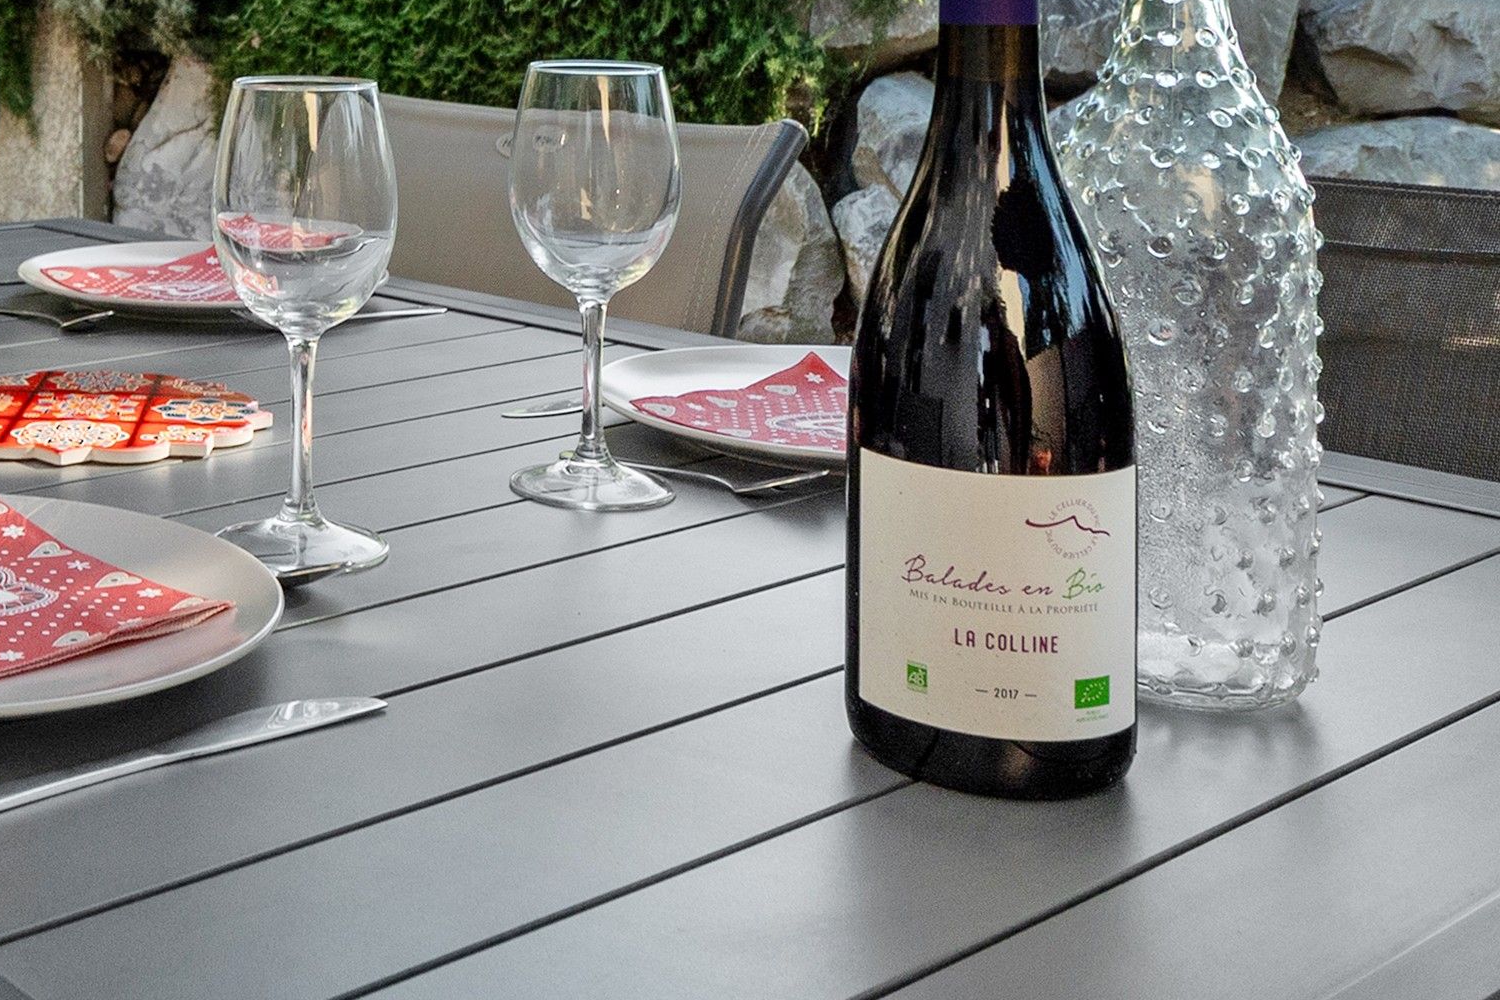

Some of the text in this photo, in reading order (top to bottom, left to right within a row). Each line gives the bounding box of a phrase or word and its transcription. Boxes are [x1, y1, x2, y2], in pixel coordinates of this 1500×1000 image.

[901, 554, 1106, 600] Balades en Bio
[933, 594, 948, 605] EN
[1029, 606, 1043, 615] LA
[954, 627, 1059, 654] LA COLLINE
[993, 687, 1019, 700] 2017
